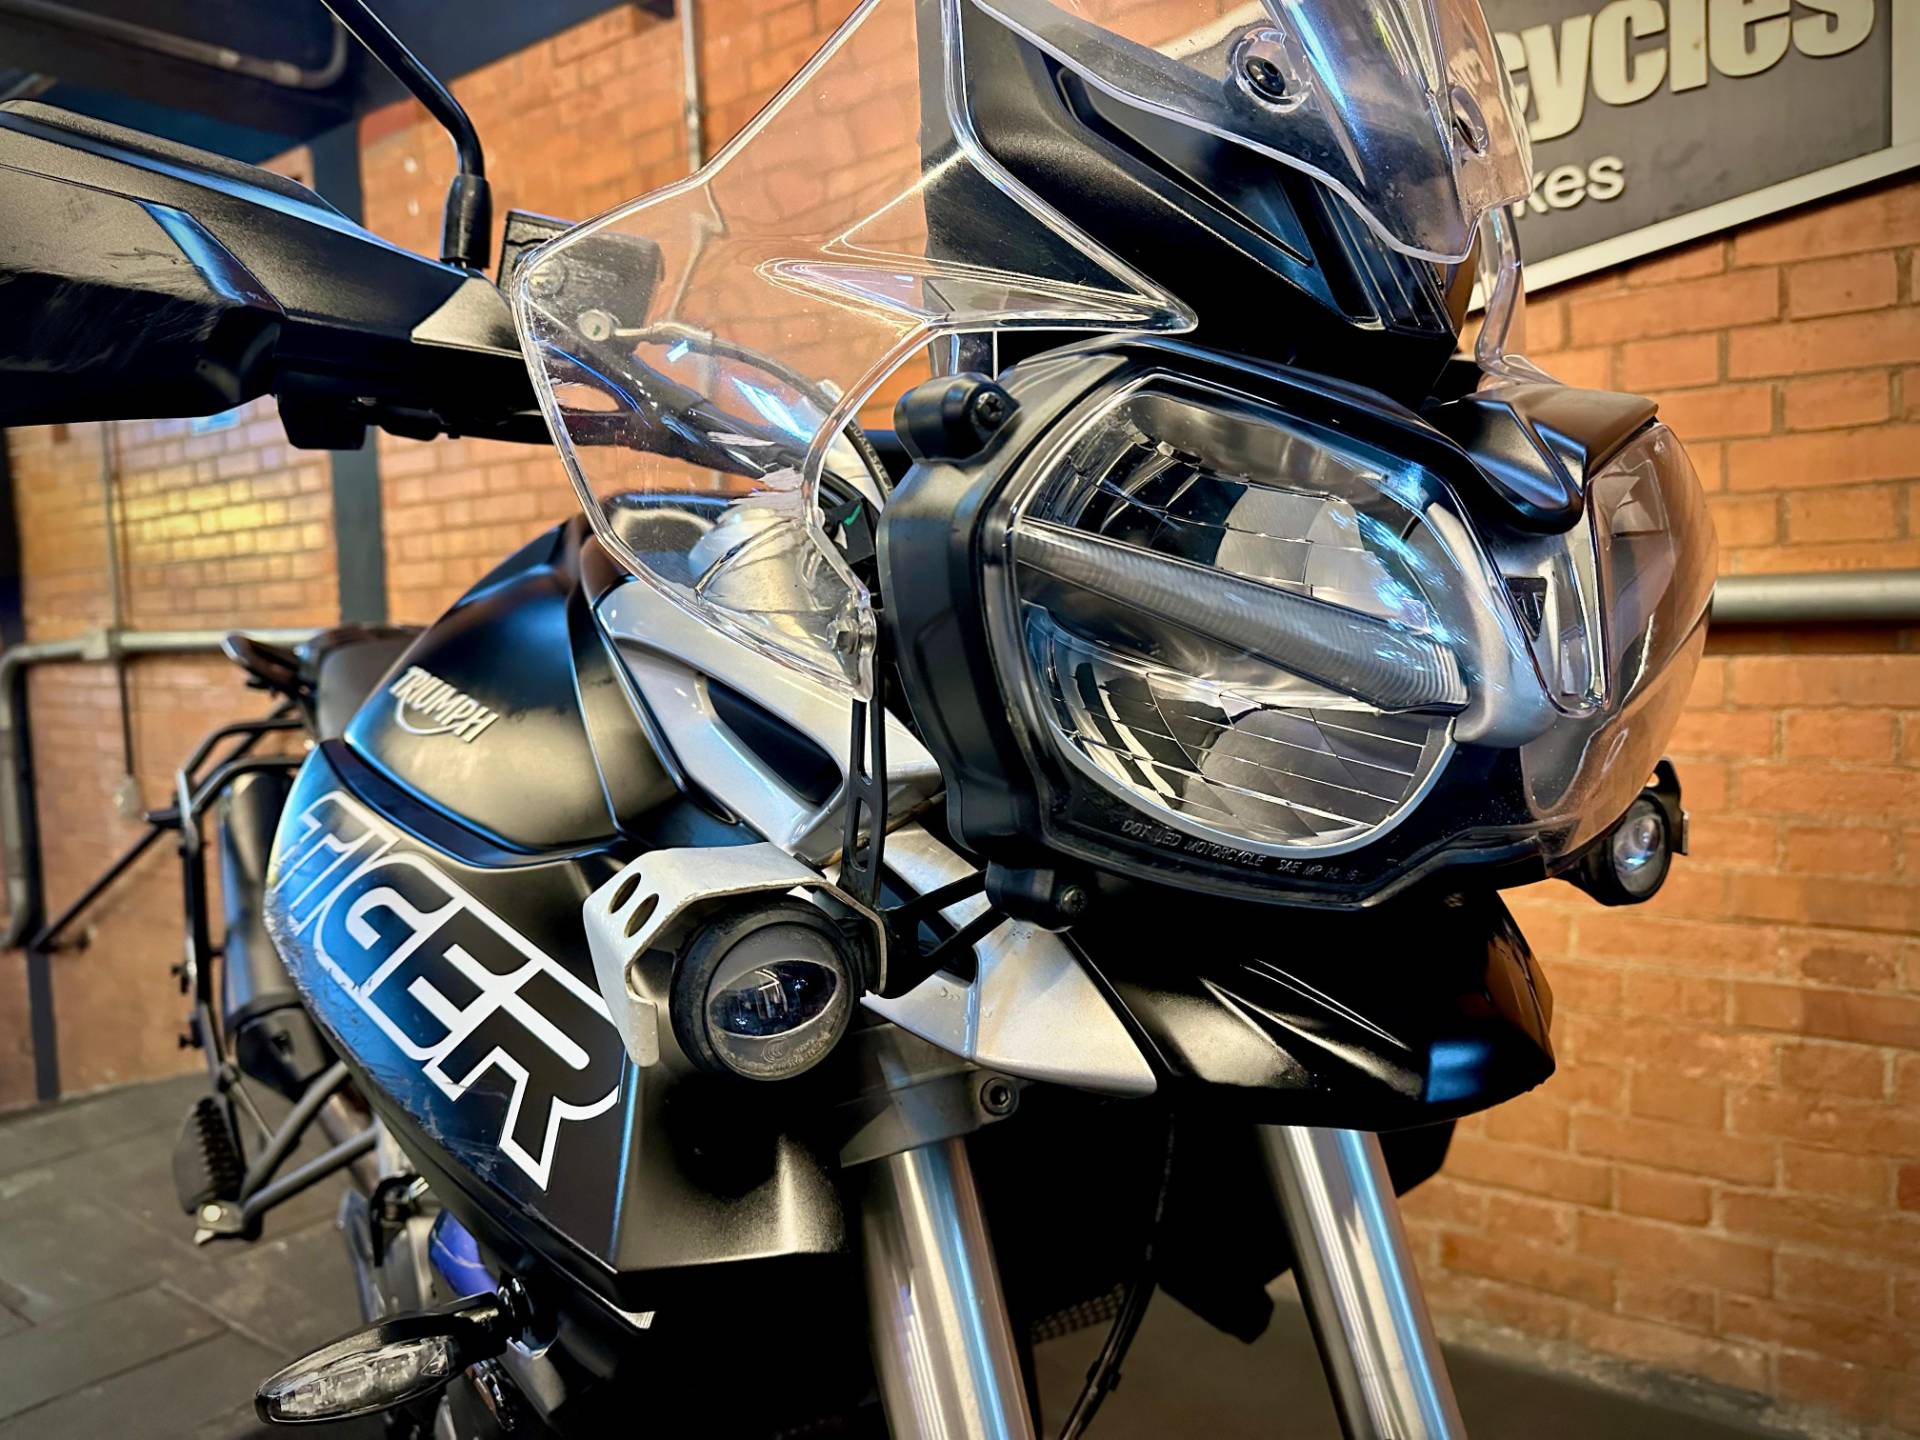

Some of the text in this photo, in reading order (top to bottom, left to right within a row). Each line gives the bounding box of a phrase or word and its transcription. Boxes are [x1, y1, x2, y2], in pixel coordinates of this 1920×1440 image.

[388, 665, 499, 743] TRIUMPH
[1121, 819, 1152, 838] DOT
[1154, 828, 1182, 847] LED
[1184, 840, 1267, 867] MOTORCYCLE
[273, 790, 621, 1192] TIGER
